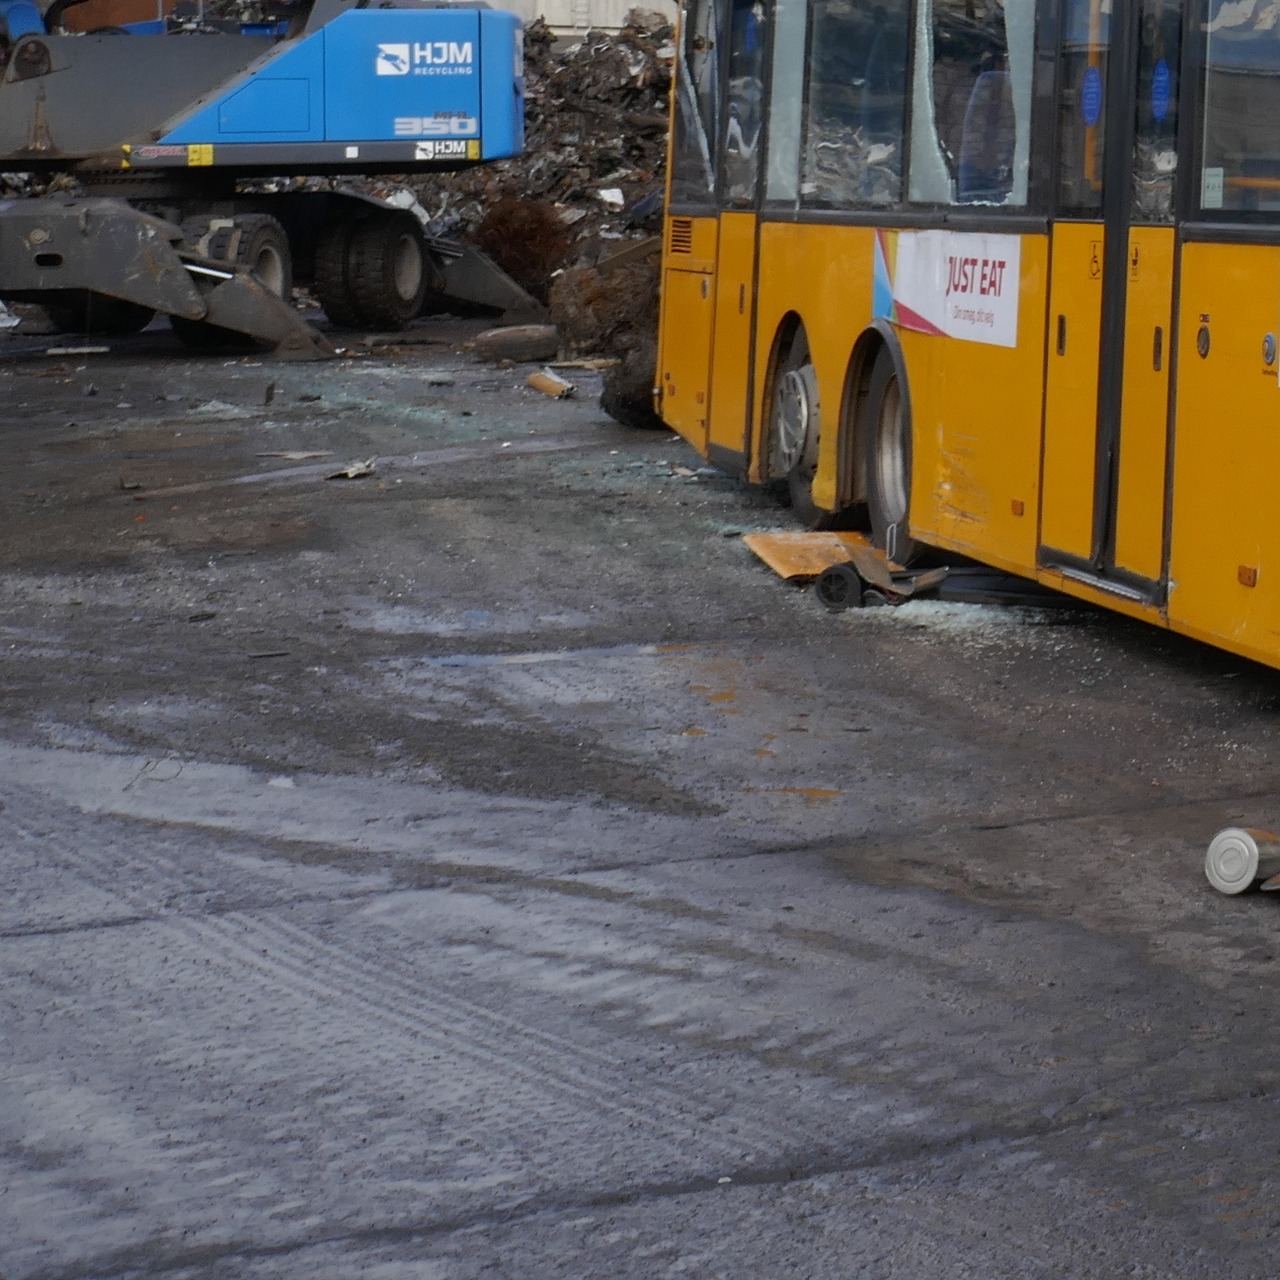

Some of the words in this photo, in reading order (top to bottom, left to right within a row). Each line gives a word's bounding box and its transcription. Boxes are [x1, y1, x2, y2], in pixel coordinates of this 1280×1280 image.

[414, 41, 473, 64] HJM
[414, 66, 473, 75] RECYCLING
[394, 117, 478, 136] 350
[434, 140, 466, 154] HJM
[945, 255, 979, 298] JUST
[979, 258, 1007, 297] EAT
